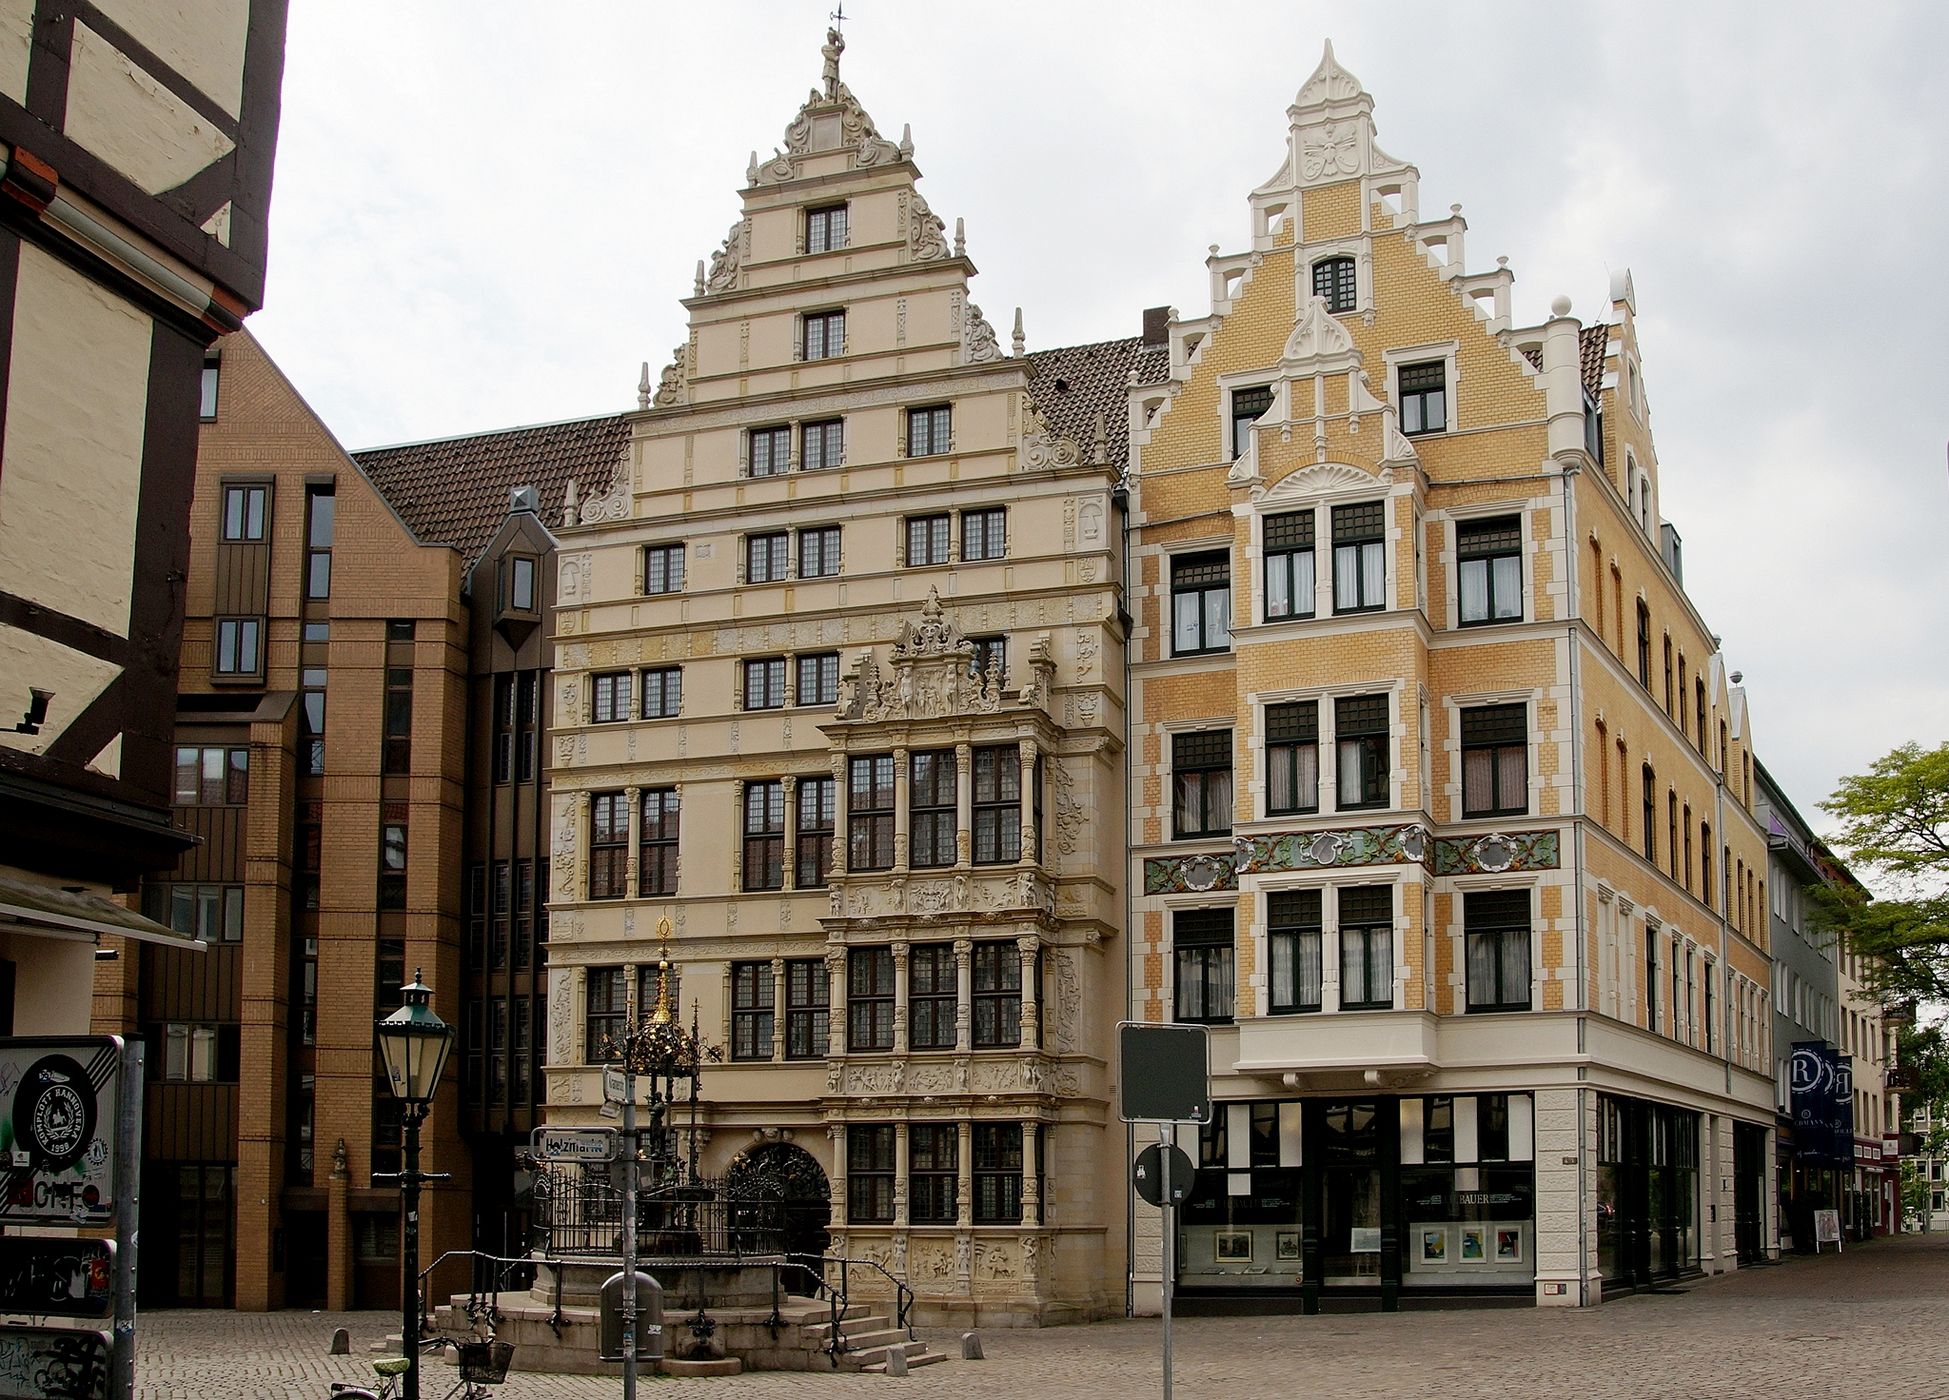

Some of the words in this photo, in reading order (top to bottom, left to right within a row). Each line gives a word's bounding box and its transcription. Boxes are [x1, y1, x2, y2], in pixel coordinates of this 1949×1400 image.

[1792, 1059, 1812, 1082] R
[36, 1092, 52, 1146] KOMPLOTT
[1459, 1193, 1490, 1205] BAUER
